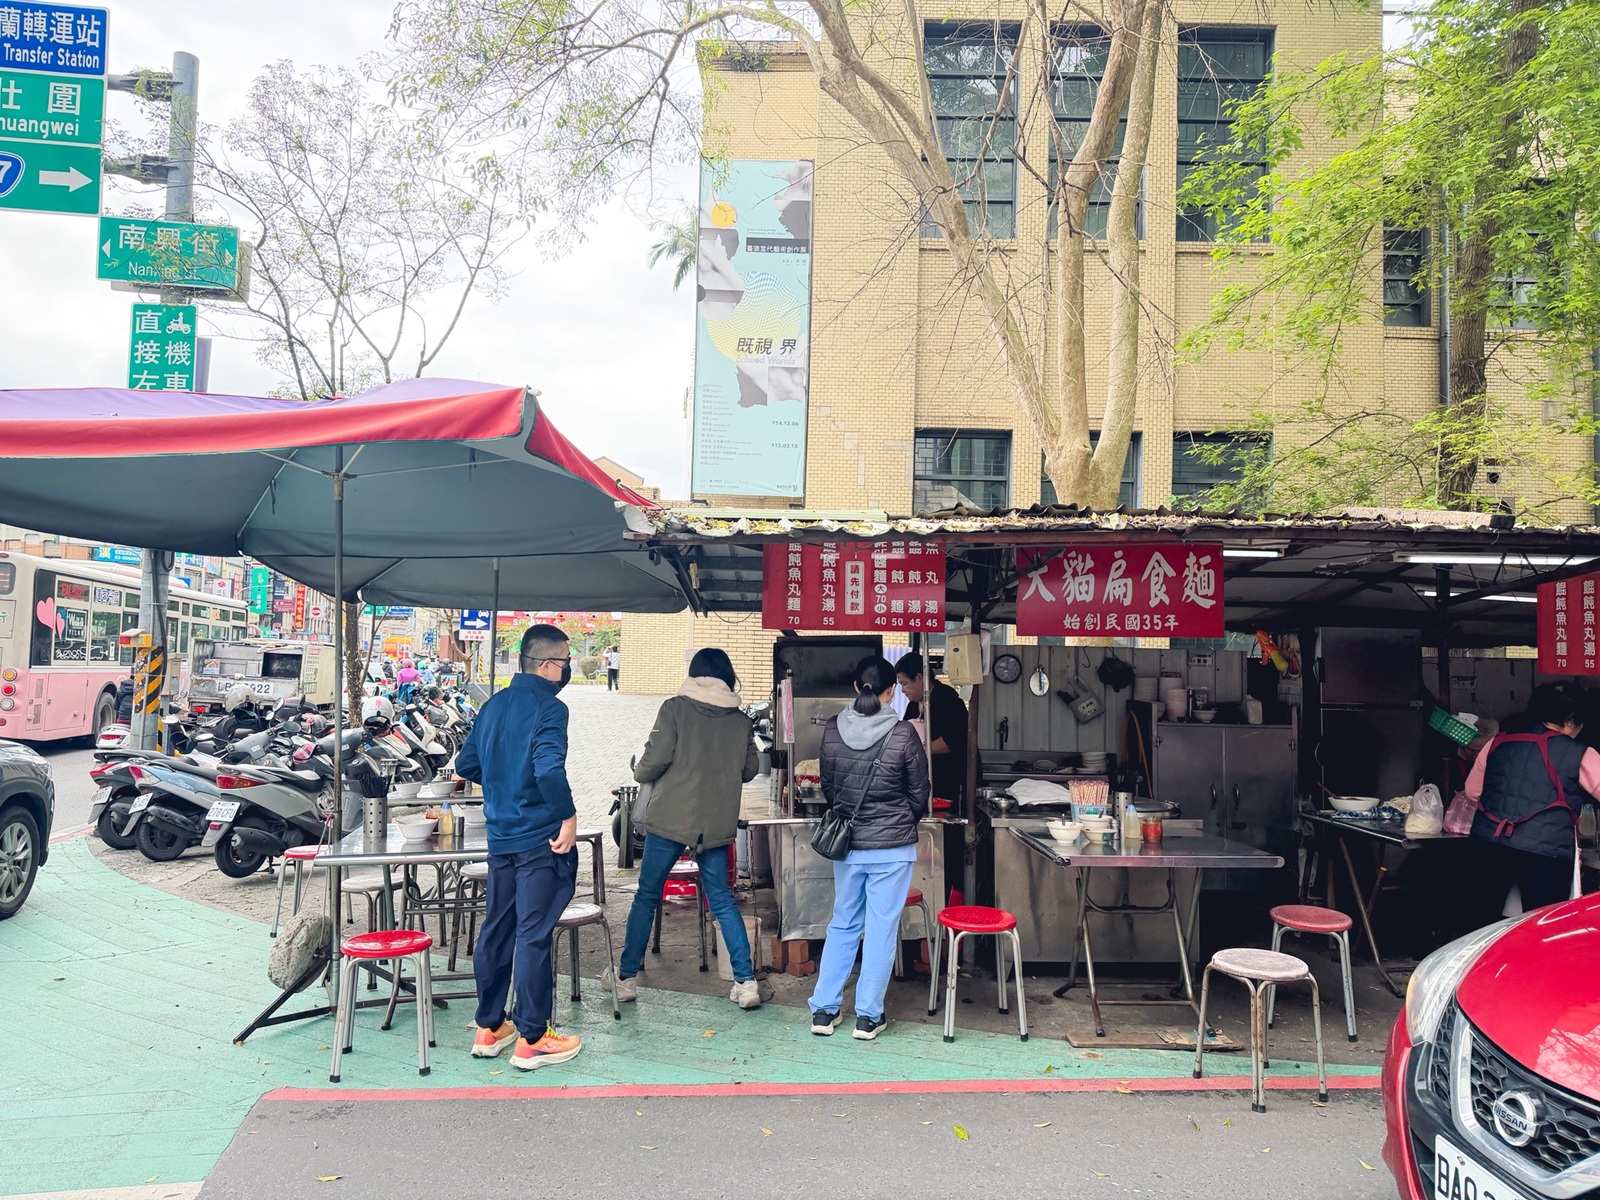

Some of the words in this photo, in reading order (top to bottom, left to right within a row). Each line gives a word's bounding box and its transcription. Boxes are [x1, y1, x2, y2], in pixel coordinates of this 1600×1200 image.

[4, 43, 54, 64] Transfer
[57, 47, 100, 68] Station
[850, 564, 860, 612] 請先付款
[875, 584, 887, 593] 大
[876, 595, 887, 604] 70
[875, 604, 886, 613] 小
[788, 616, 800, 625] 70
[823, 617, 835, 626] 55
[875, 617, 887, 626] 40
[891, 618, 904, 627] 50
[909, 618, 921, 627] 45
[926, 619, 938, 628] 45
[1062, 613, 1180, 632] 始創民國35年
[1556, 658, 1567, 668] 70
[1584, 659, 1595, 668] 55
[1495, 1105, 1528, 1132] NISSAN
